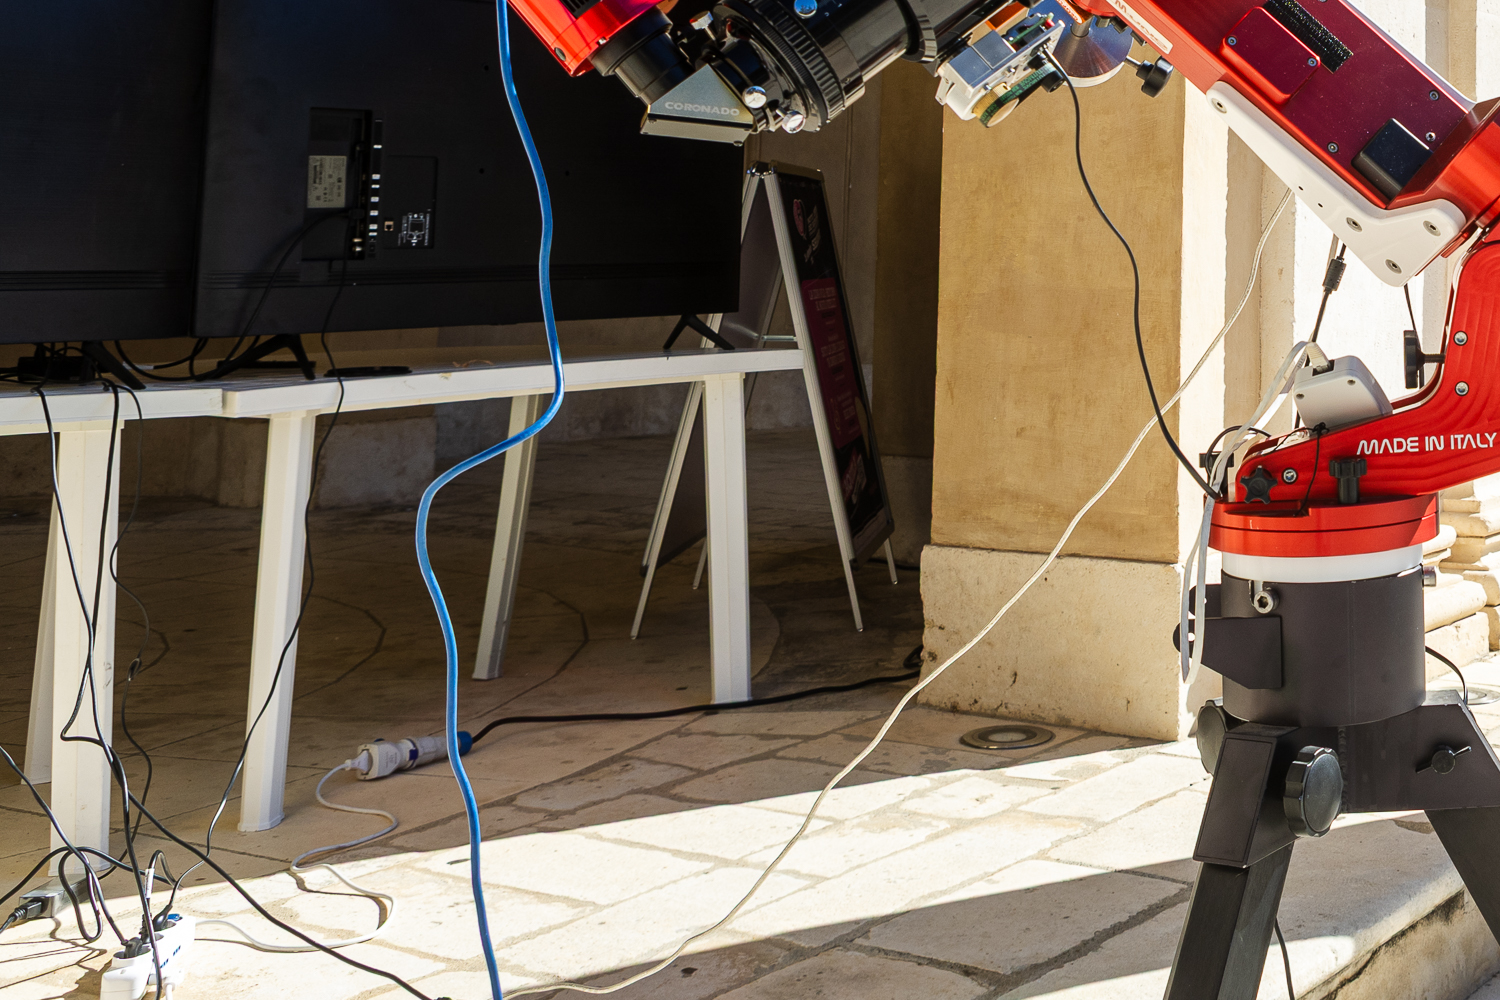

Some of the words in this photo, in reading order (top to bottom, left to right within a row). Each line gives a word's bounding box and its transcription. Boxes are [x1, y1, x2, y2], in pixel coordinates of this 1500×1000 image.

[664, 101, 740, 116] CORONADO
[1356, 436, 1420, 455] MADE
[1425, 435, 1445, 452] IN
[1450, 432, 1497, 450] ITALY
